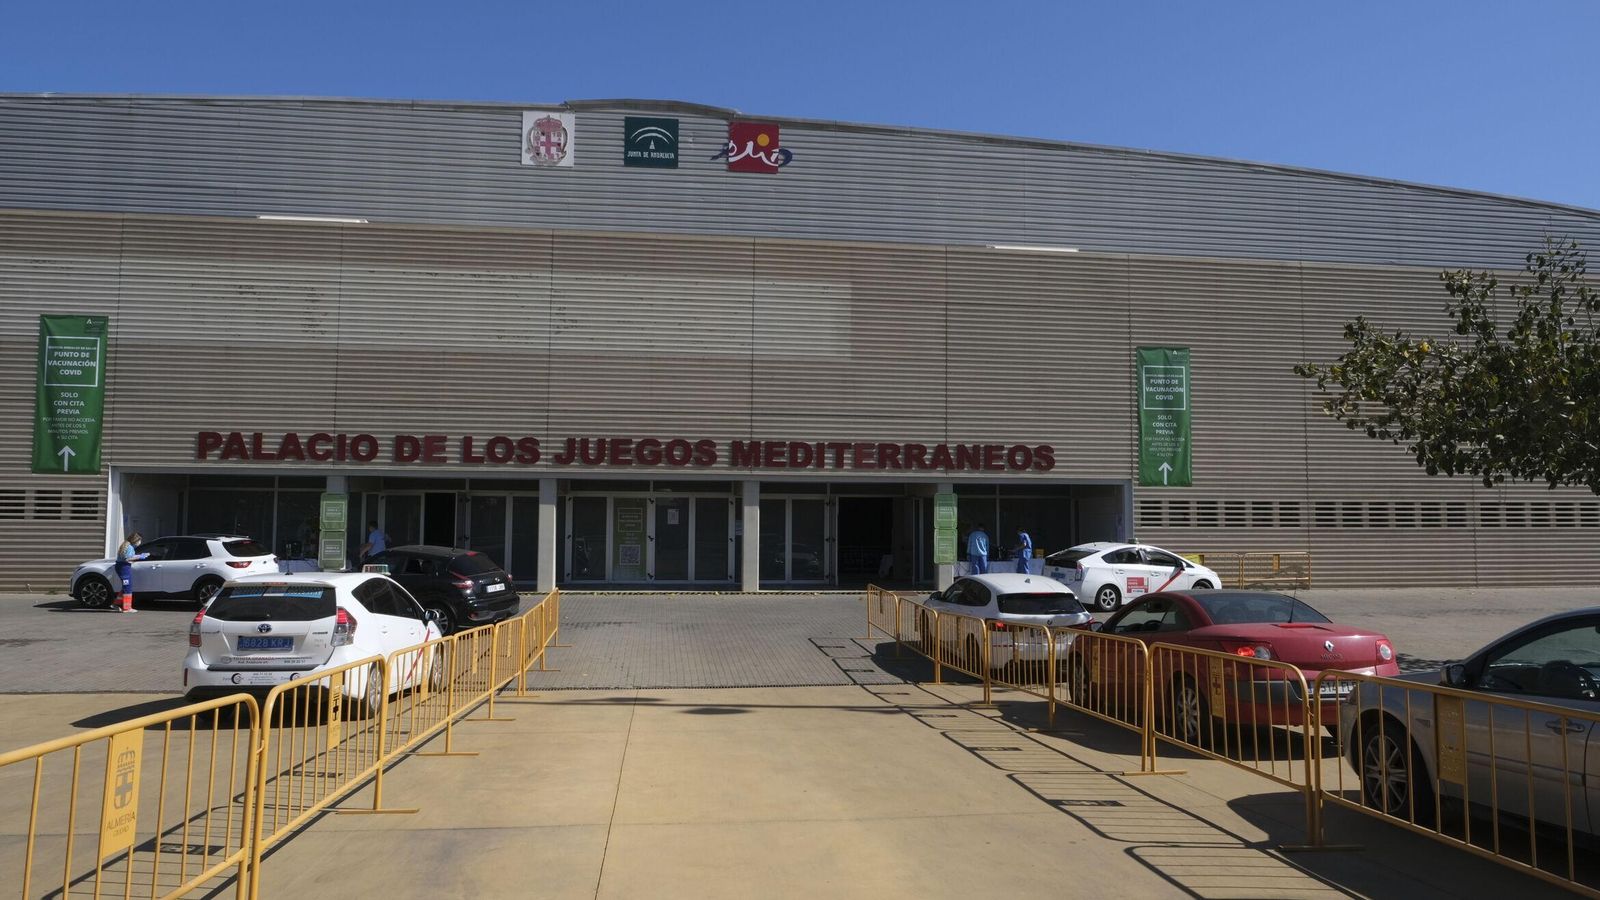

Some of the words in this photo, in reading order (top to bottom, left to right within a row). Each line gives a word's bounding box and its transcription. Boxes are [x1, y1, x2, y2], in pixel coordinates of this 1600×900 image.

[47, 359, 97, 367] VACUNACIÓN
[197, 431, 380, 463] PALACIO
[393, 434, 448, 463] DE
[459, 435, 542, 464] LOS
[554, 437, 717, 467] JUEGOS
[731, 440, 1056, 471] MEDITERRANEOS
